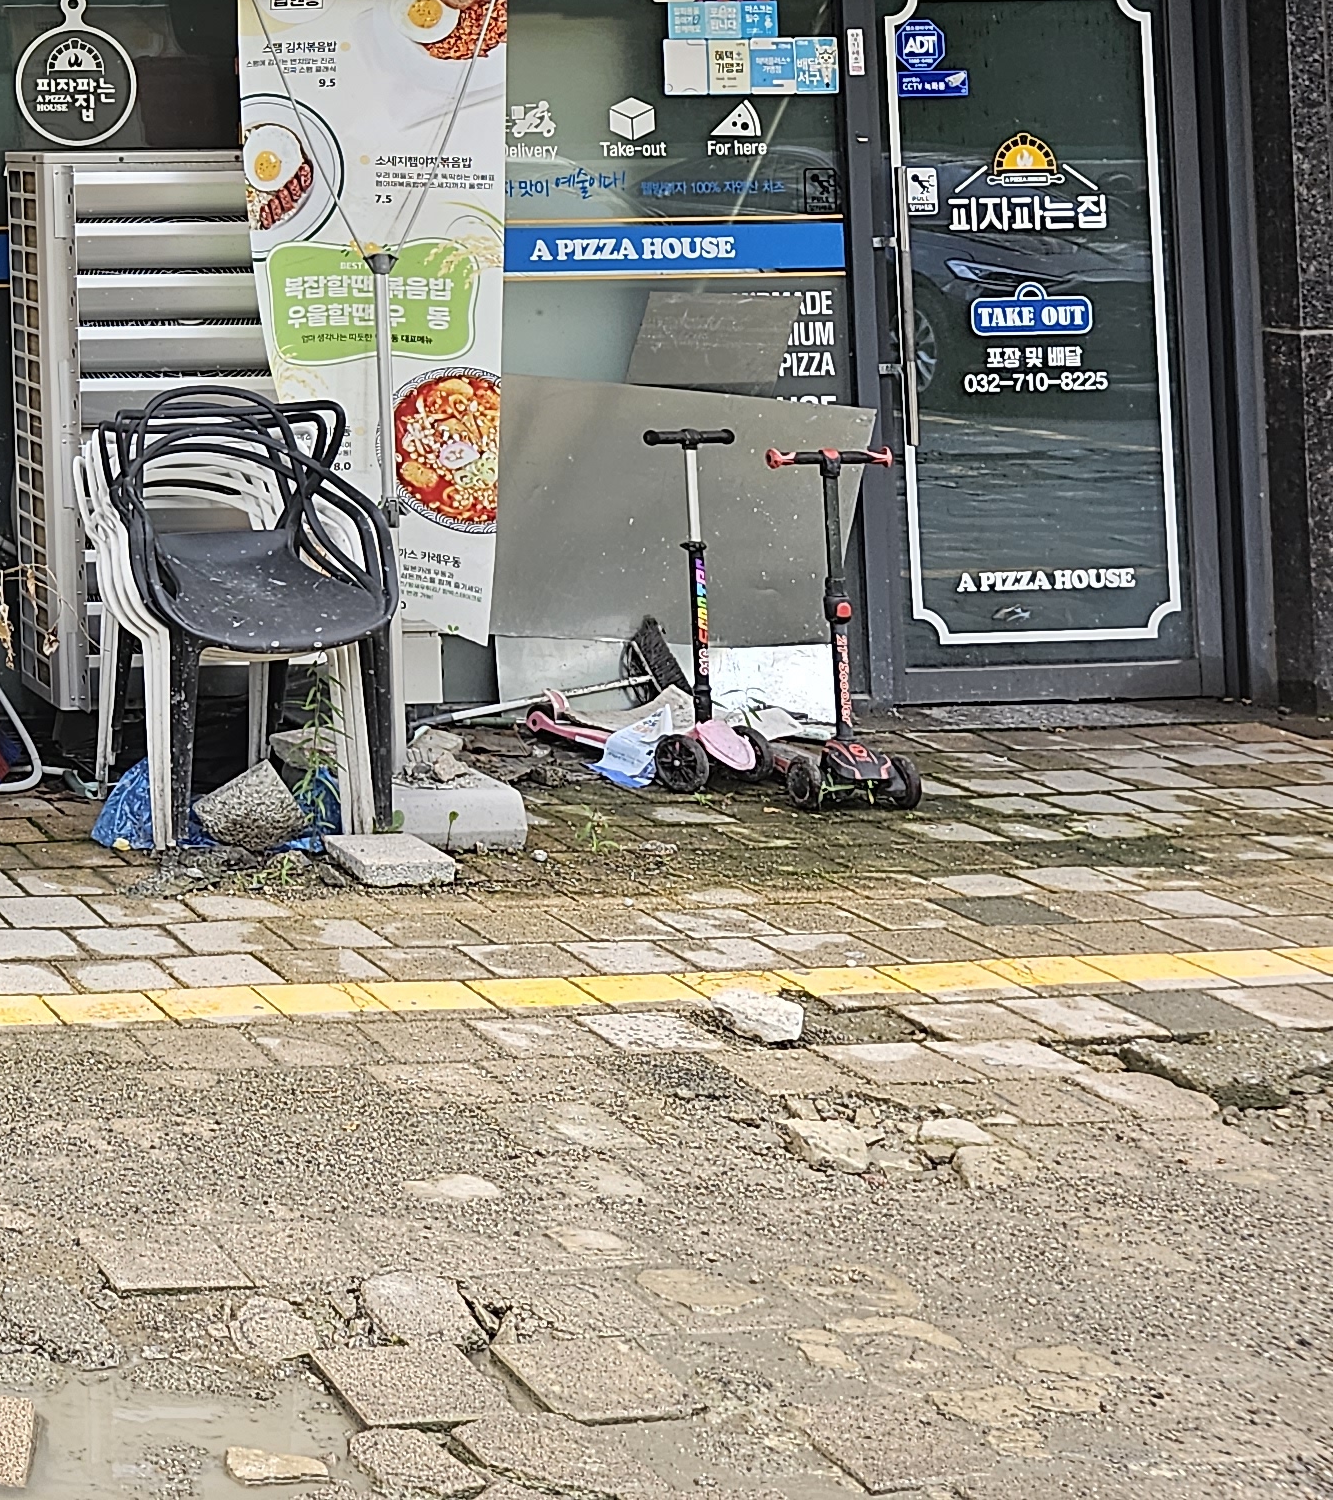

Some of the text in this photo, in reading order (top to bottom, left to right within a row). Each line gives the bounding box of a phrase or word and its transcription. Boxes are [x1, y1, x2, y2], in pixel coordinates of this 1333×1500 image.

[285, 41, 337, 53] 김치볶음밥
[903, 35, 937, 54] ADT
[715, 62, 744, 74] 가맹점
[318, 78, 336, 88] 9.5
[797, 71, 821, 85] 서구
[902, 82, 923, 90] CCTV
[36, 78, 116, 103] 피자파는
[45, 95, 73, 103] PIZZA
[36, 104, 69, 112] HOUSE
[74, 94, 95, 121] 집
[600, 142, 667, 158] Take-out
[707, 141, 768, 156] For here
[518, 168, 626, 199] 맛이 예술이다!
[690, 180, 721, 194] 100%
[374, 194, 392, 204] 7.5
[947, 193, 1107, 232] 피자파는집
[530, 236, 736, 261] A PIZZA HOUSE
[339, 261, 362, 270] BEST
[285, 275, 375, 300] 복잡할땐
[287, 303, 375, 329] 우울할땐
[977, 305, 1086, 328] TAKE OUT
[317, 332, 347, 342] 생각나는
[400, 334, 433, 344] 대표메뉴
[779, 351, 836, 376] PIZZA
[986, 346, 1083, 369] 포장 및 배달
[963, 371, 1108, 394] 032-710-8225
[333, 461, 352, 471] 8.0
[420, 550, 462, 569] 카레우동
[956, 568, 1136, 592] A PIZZA HOUSE
